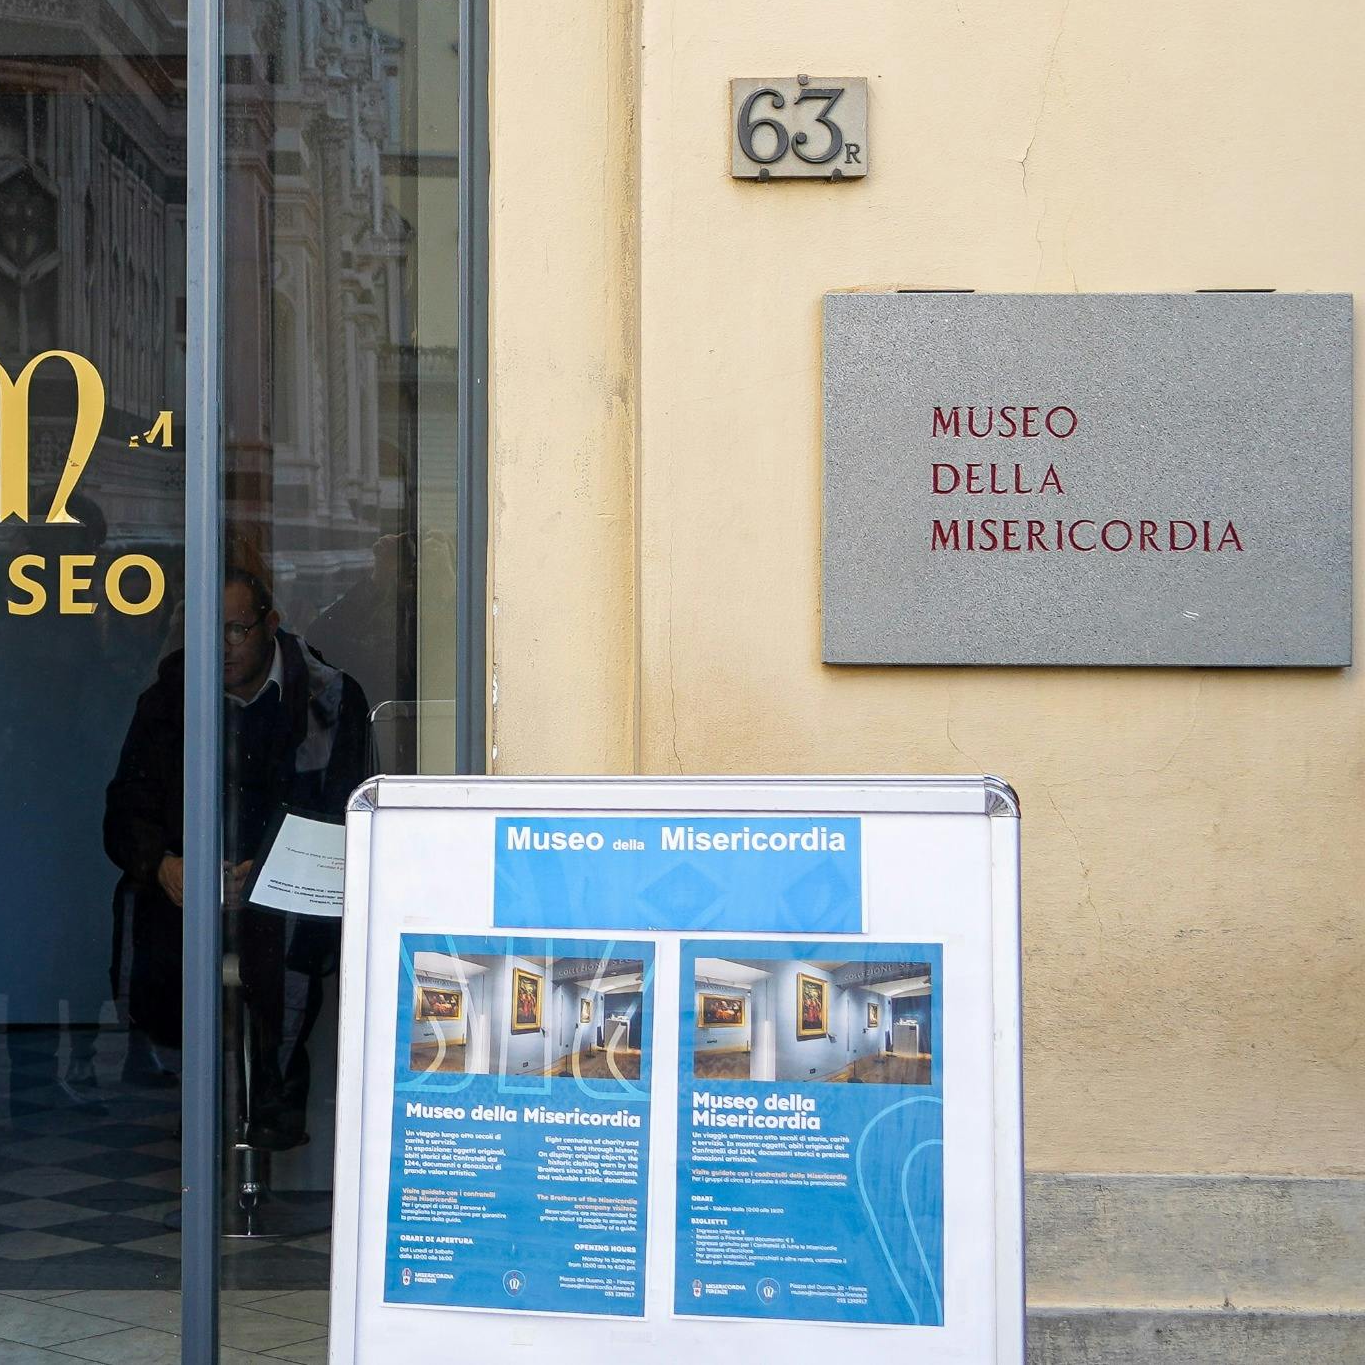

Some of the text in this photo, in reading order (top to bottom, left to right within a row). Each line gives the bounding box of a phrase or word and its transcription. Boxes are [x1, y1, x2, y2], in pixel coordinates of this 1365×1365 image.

[736, 87, 861, 165] 63 R
[931, 406, 1078, 438] MUSEO
[931, 463, 1065, 495] DELLA
[931, 520, 1245, 552] MISERICORDIA
[507, 826, 845, 851] Museo della Misericordia
[692, 1091, 815, 1111] Museo della
[406, 1103, 641, 1128] Museo della Misericordia
[692, 1108, 820, 1130] Misericordia
[602, 1139, 625, 1147] charity
[436, 1236, 474, 1244] APERTURA
[574, 1244, 636, 1253] OPENING HOURS
